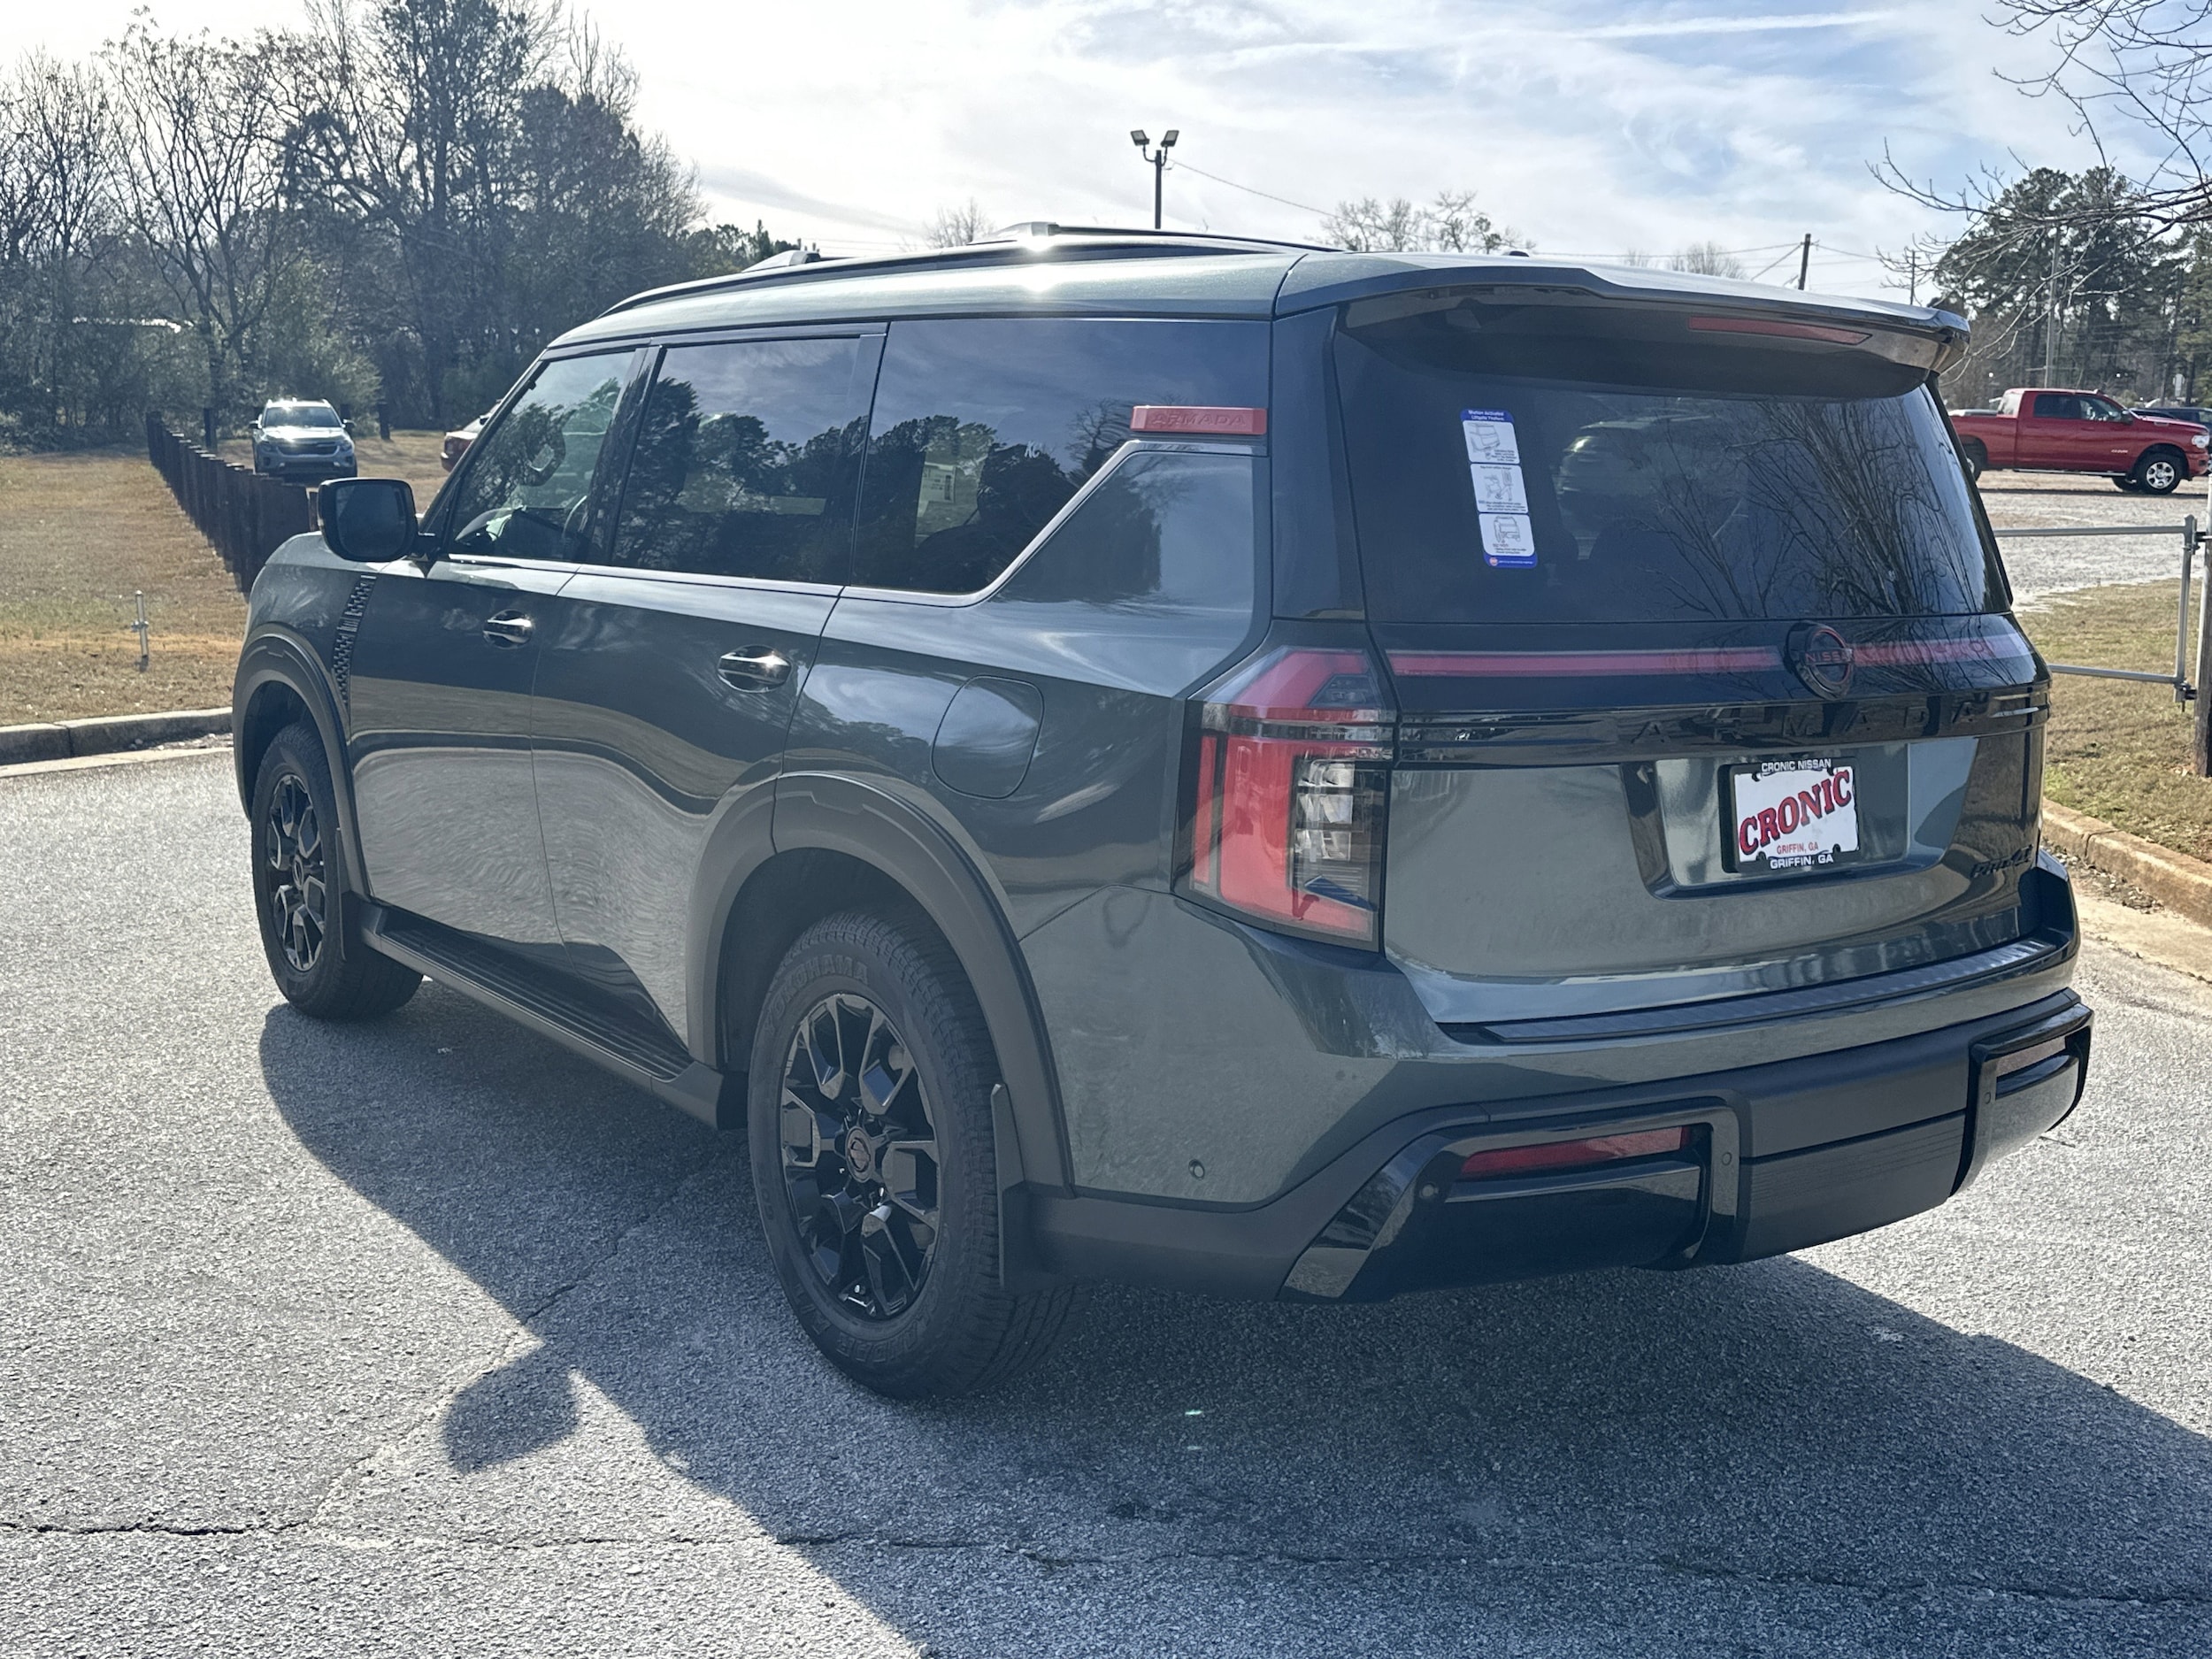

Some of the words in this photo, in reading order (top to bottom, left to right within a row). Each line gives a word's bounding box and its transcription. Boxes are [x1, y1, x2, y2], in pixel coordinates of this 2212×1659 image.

[1152, 412, 1246, 426] ARMADA
[1761, 761, 1796, 772] CRONIC
[1797, 758, 1832, 771] NISSAN
[1739, 770, 1852, 856] CRONIC
[1777, 842, 1807, 855] GRIFFIN,
[1808, 841, 1819, 851] GA
[1770, 856, 1815, 869] GRIFFIN,
[1817, 854, 1834, 864] GA
[762, 954, 868, 1036] YOKOHAMA
